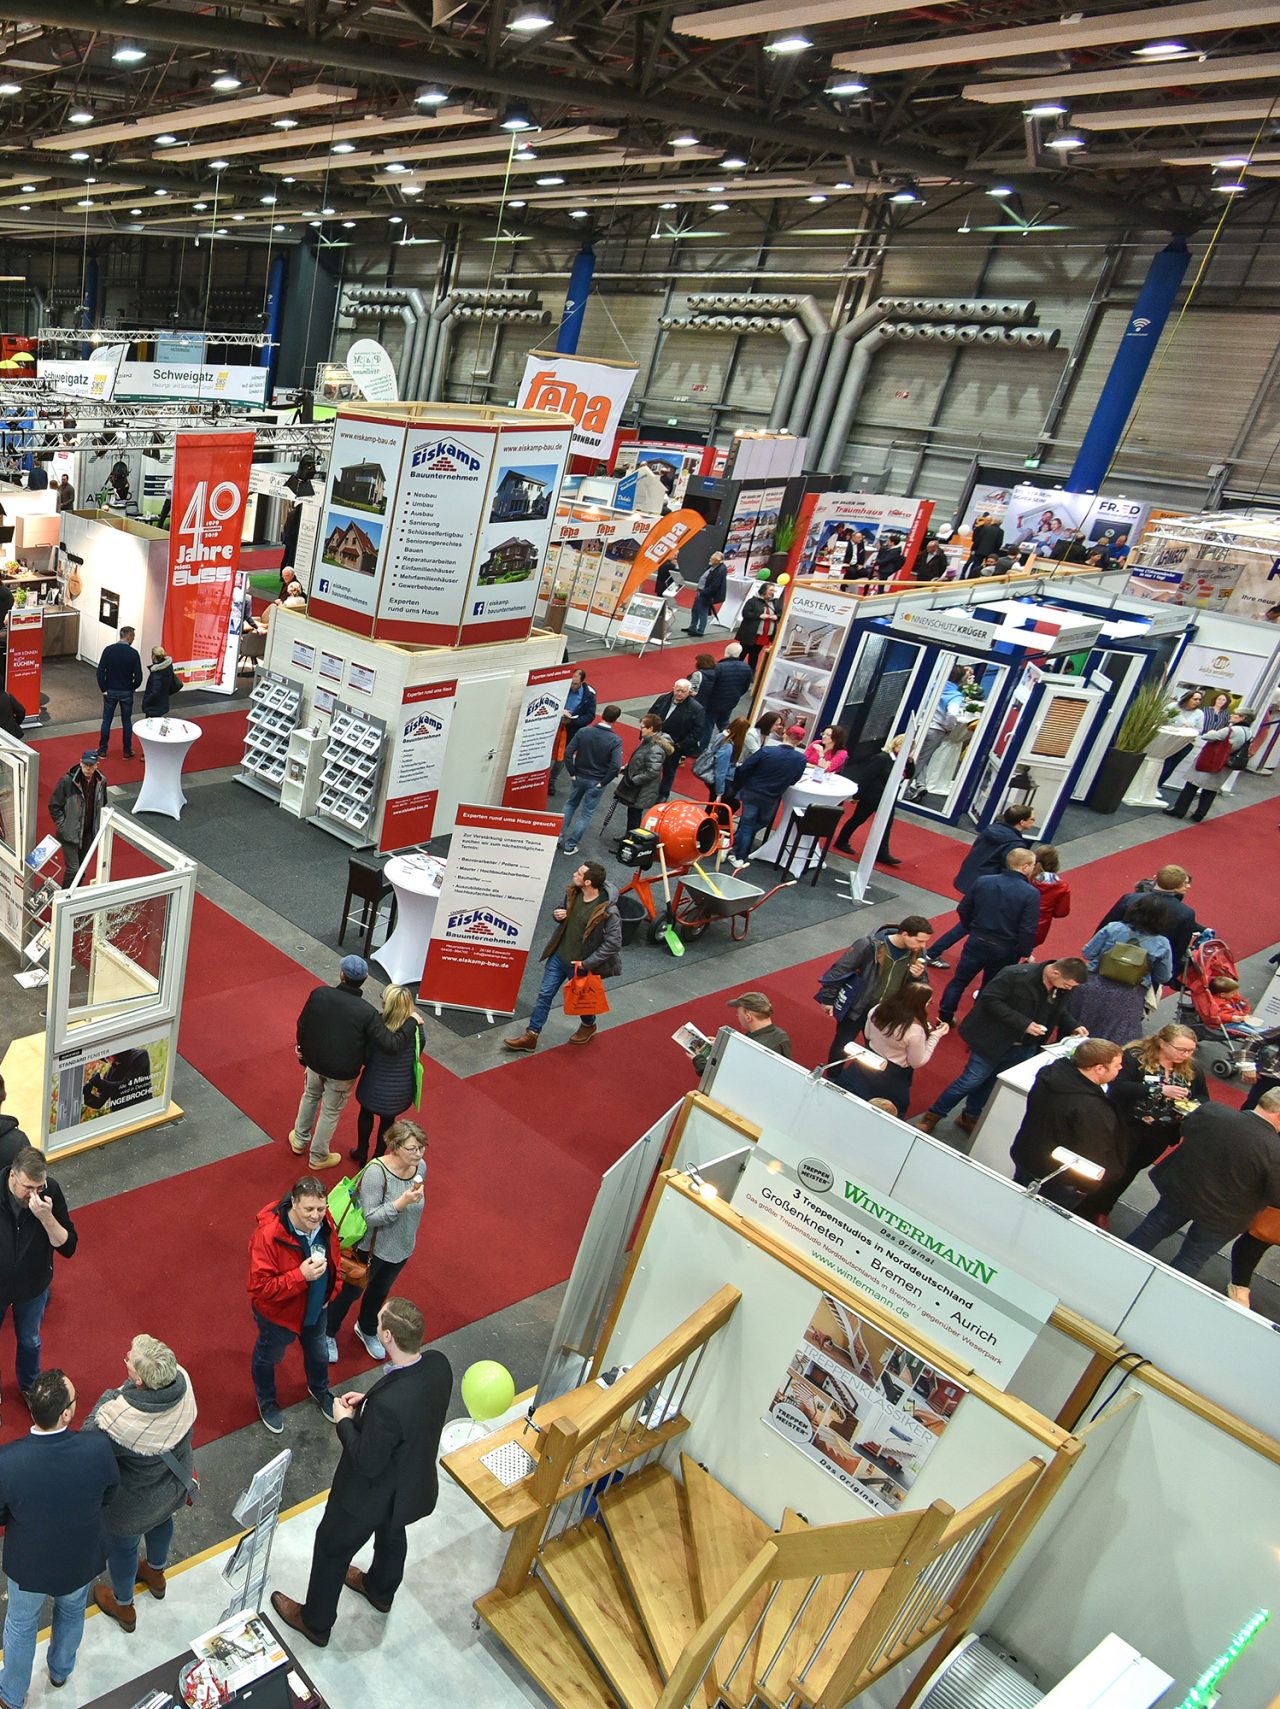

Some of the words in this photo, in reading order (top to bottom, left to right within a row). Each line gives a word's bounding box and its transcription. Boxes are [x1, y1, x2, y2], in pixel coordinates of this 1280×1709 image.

[153, 369, 214, 384] Schweigatz
[340, 431, 397, 446] www.eiskamp-bau.de
[503, 443, 563, 453] www.eiskamp-bau.de
[411, 442, 480, 471] Eiskamp
[410, 471, 478, 482] Bauunternehmen
[410, 510, 434, 518] Ausbau
[835, 506, 883, 516] Traumhaus
[408, 520, 440, 528] Sanierung
[596, 523, 616, 536] fepa
[407, 528, 464, 539] Schlüsselfertigbau
[644, 521, 688, 562] fepa
[175, 543, 234, 564] Jahre
[404, 546, 424, 554] Bauen
[402, 556, 457, 566] Reparaturarbeiten
[172, 566, 232, 586] BUSS
[401, 564, 455, 574] Einfamilienhäuser
[399, 573, 459, 584] Mehrfamilienhäuser
[398, 582, 445, 592] Gewerbebauten
[389, 597, 420, 607] Experten
[792, 596, 836, 613] CARSTENS
[1242, 594, 1256, 602] Ihre
[1257, 597, 1276, 605] neue
[421, 607, 439, 616] Haus
[957, 624, 988, 639] KRÜGER
[526, 696, 560, 717] Eiskamp
[403, 715, 443, 737] Eiskamp
[462, 812, 488, 820] Experten
[447, 911, 518, 937] Eiskamp
[446, 931, 516, 946] Bauunternehmen
[442, 955, 509, 968] www.eiskamp-bau.de
[58, 1056, 87, 1069] STANDARD
[87, 1049, 110, 1060] FENSTER
[802, 1164, 830, 1180] TREPPEN
[843, 1180, 998, 1285] WINTERMANN
[792, 1189, 802, 1200] 3
[802, 1196, 872, 1246] Treppenstudios
[874, 1242, 884, 1253] in
[885, 1249, 974, 1310] Norddeutschland
[879, 1228, 896, 1242] Das
[898, 1239, 935, 1266] Original
[760, 1187, 844, 1248] Großenkneten
[870, 1258, 923, 1297] Bremen
[950, 1311, 998, 1346] Aurich
[745, 1193, 758, 1203] Das
[757, 1200, 779, 1218] größte
[778, 1214, 822, 1247] Treppenstudio
[822, 1244, 880, 1285] Norddeutschlands
[889, 1288, 916, 1308] Bremen
[920, 1310, 960, 1338] gegenüber
[962, 1336, 1003, 1366] Weserpark
[811, 1249, 910, 1319] www.wintermann.de
[803, 1345, 933, 1444] TREPPENKLASSIKER
[777, 1407, 809, 1429] TREPPEN
[819, 1458, 837, 1475] Das
[839, 1474, 879, 1508] Original
